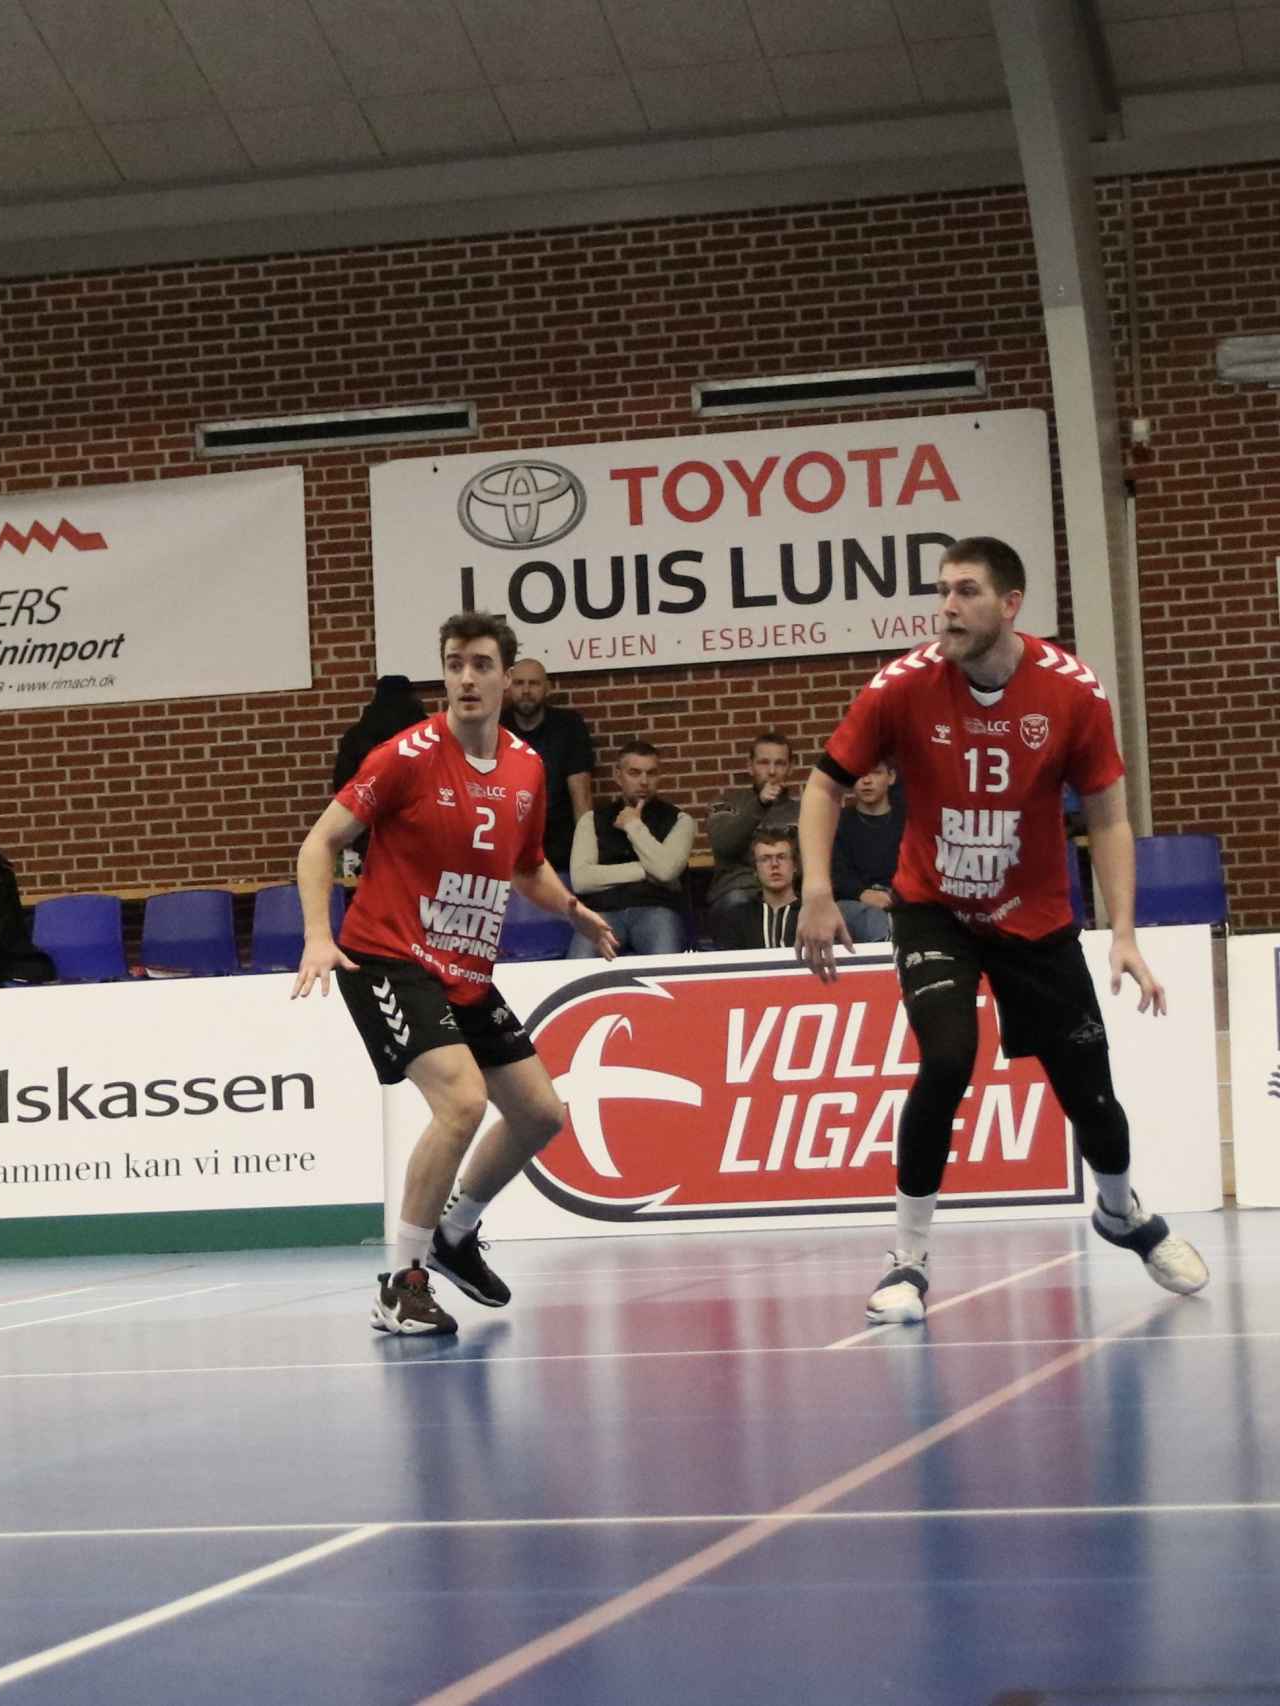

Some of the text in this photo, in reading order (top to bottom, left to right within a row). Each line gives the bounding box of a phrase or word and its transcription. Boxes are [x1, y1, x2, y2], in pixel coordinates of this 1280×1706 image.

[609, 443, 961, 526] TOYOTA
[460, 532, 958, 625] LOUIS LUND
[568, 634, 657, 660] VEJEN
[702, 621, 827, 652] ESBJERG
[986, 720, 1011, 733] LCC
[963, 747, 1010, 793] 13
[487, 785, 506, 799] LCC
[472, 806, 497, 851] 2
[941, 806, 1022, 848] BLUE
[435, 870, 512, 914] BLUE
[419, 894, 503, 948] WATE
[426, 931, 498, 962] SHIPPING
[123, 1151, 181, 1179] kan
[192, 1149, 220, 1175] vi
[231, 1152, 317, 1174] mere
